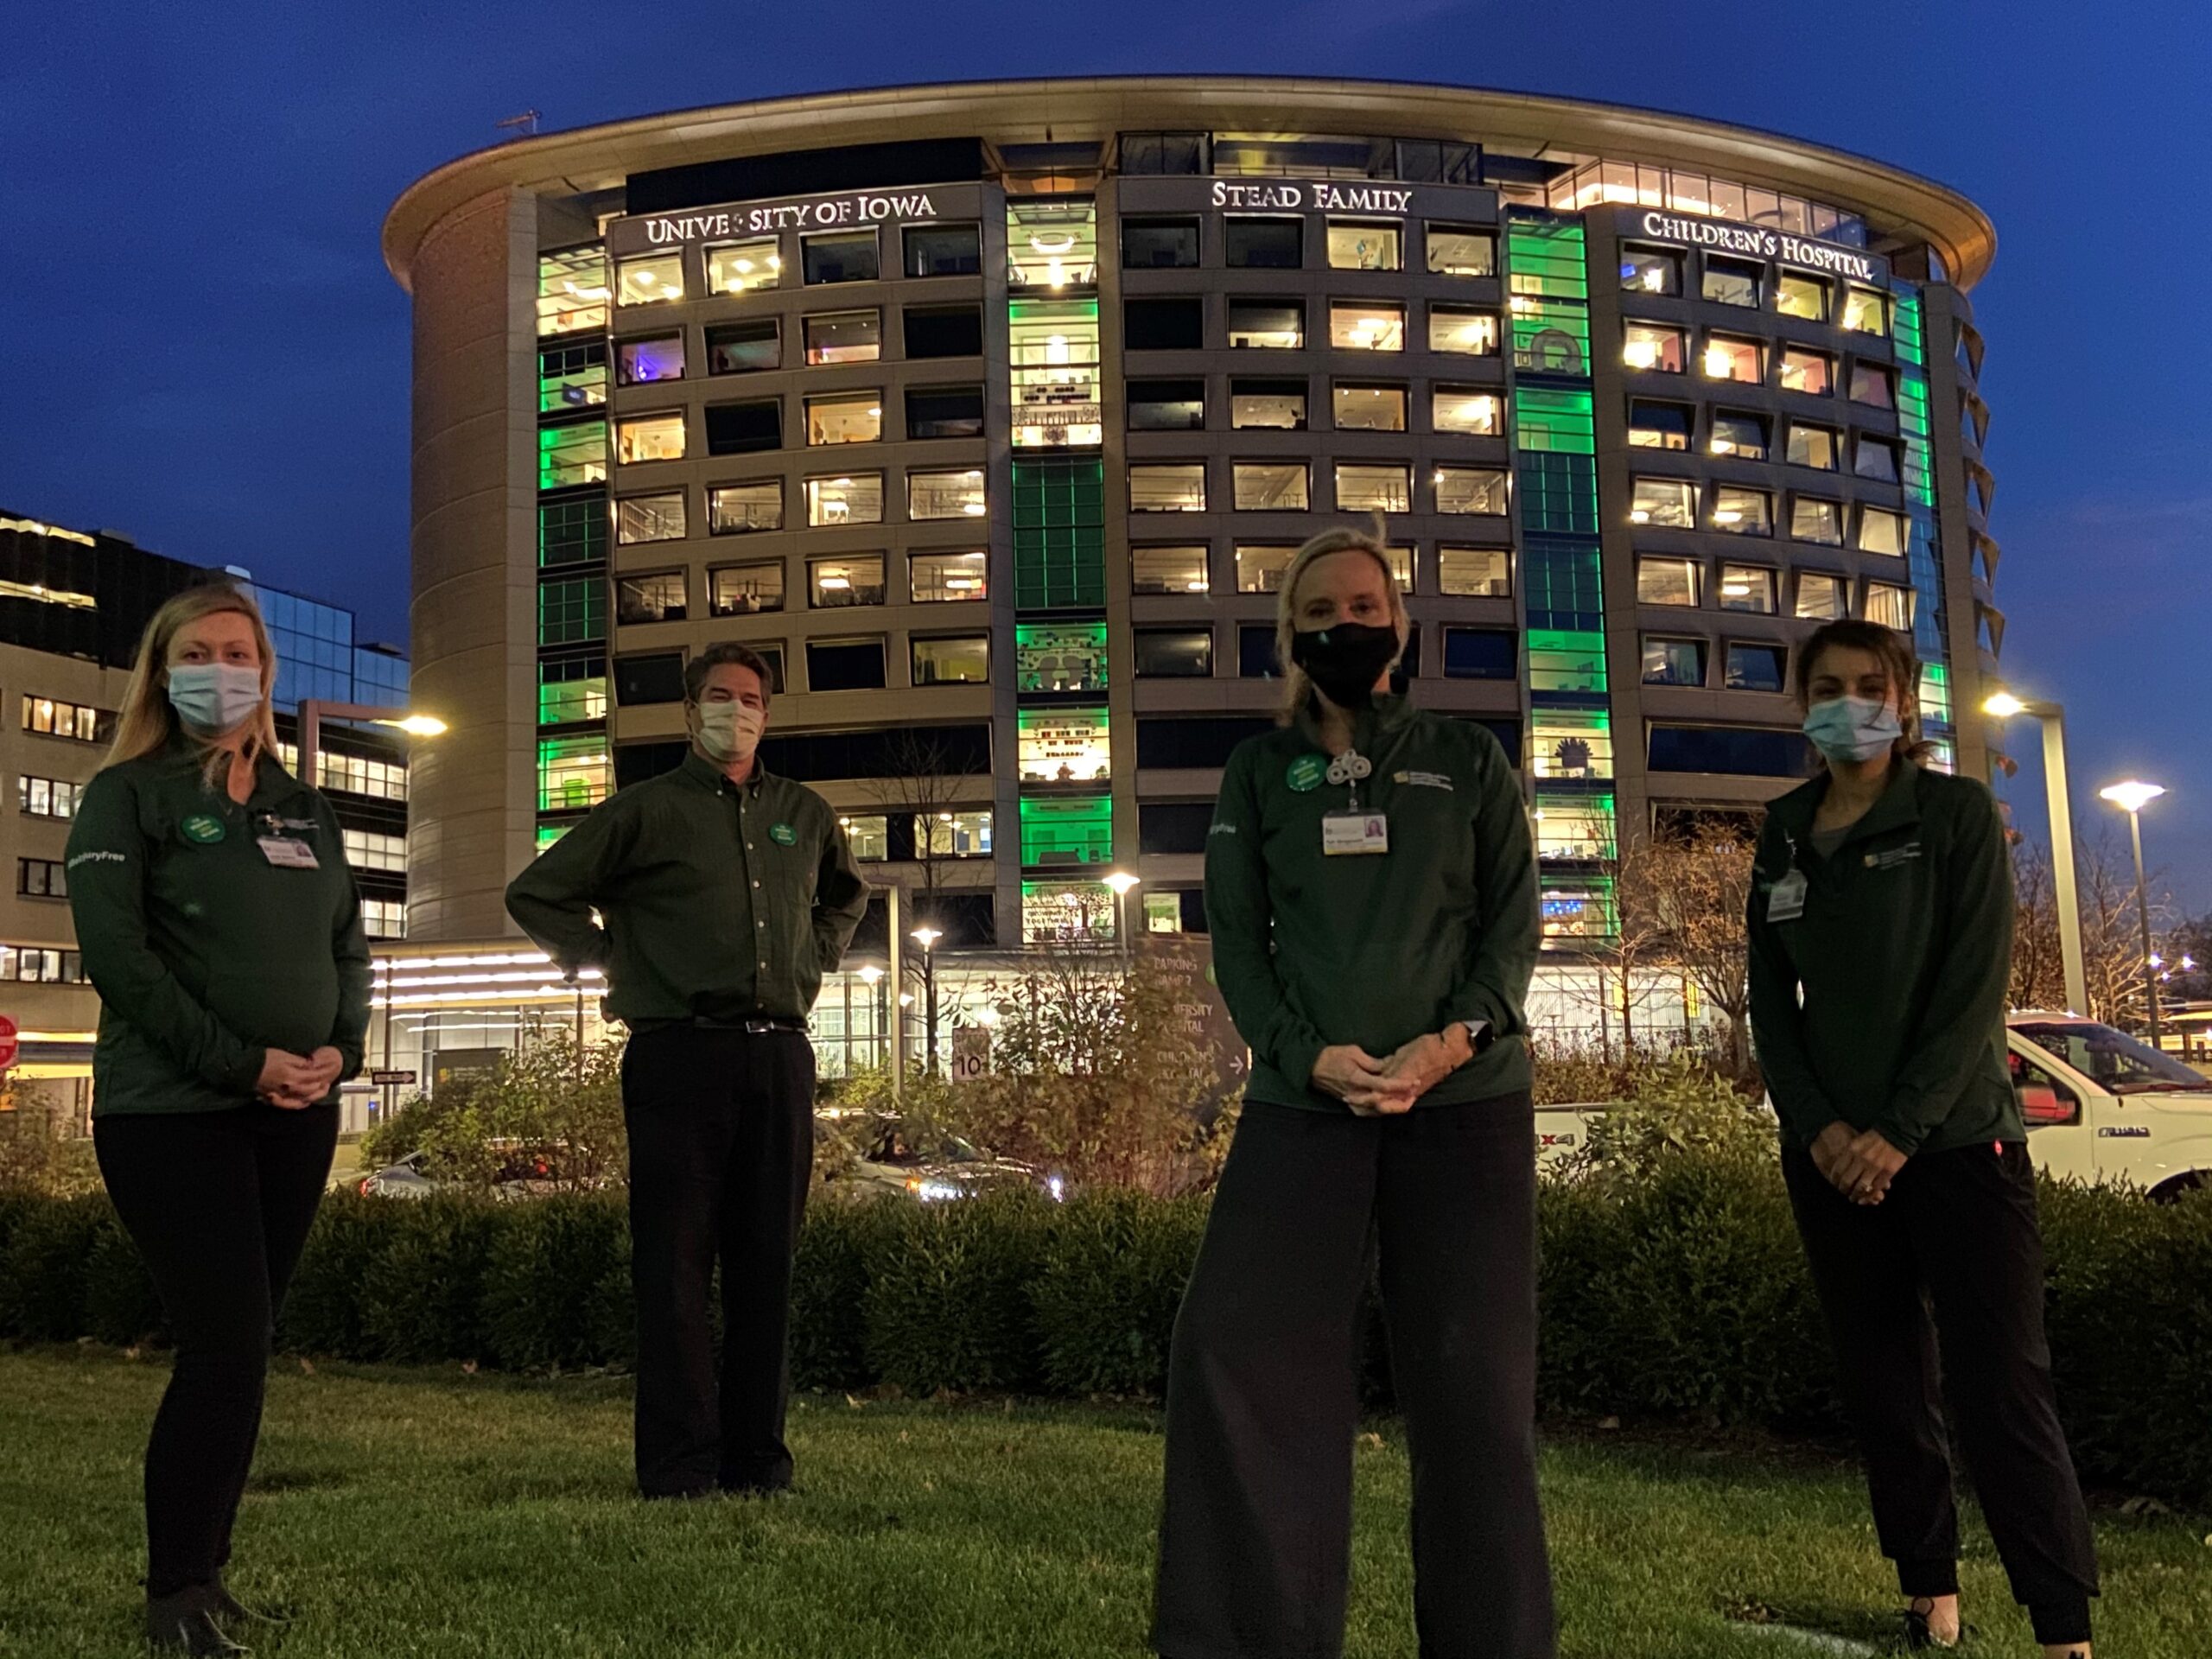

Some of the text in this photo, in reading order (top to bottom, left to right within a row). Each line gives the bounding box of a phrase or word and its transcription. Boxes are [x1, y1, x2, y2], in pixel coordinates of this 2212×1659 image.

[1212, 181, 1413, 213] STEAD FAMILY
[816, 201, 851, 225] OF
[857, 194, 937, 221] IOWA
[1643, 213, 1874, 281] CHILDREN'S HOSPITAL
[1154, 957, 1198, 971] PARKING
[1173, 1003, 1214, 1017] VERSITY
[956, 1054, 981, 1076] 10
[1157, 1050, 1215, 1064] CHILDN'S
[1535, 1134, 1575, 1147] X4
